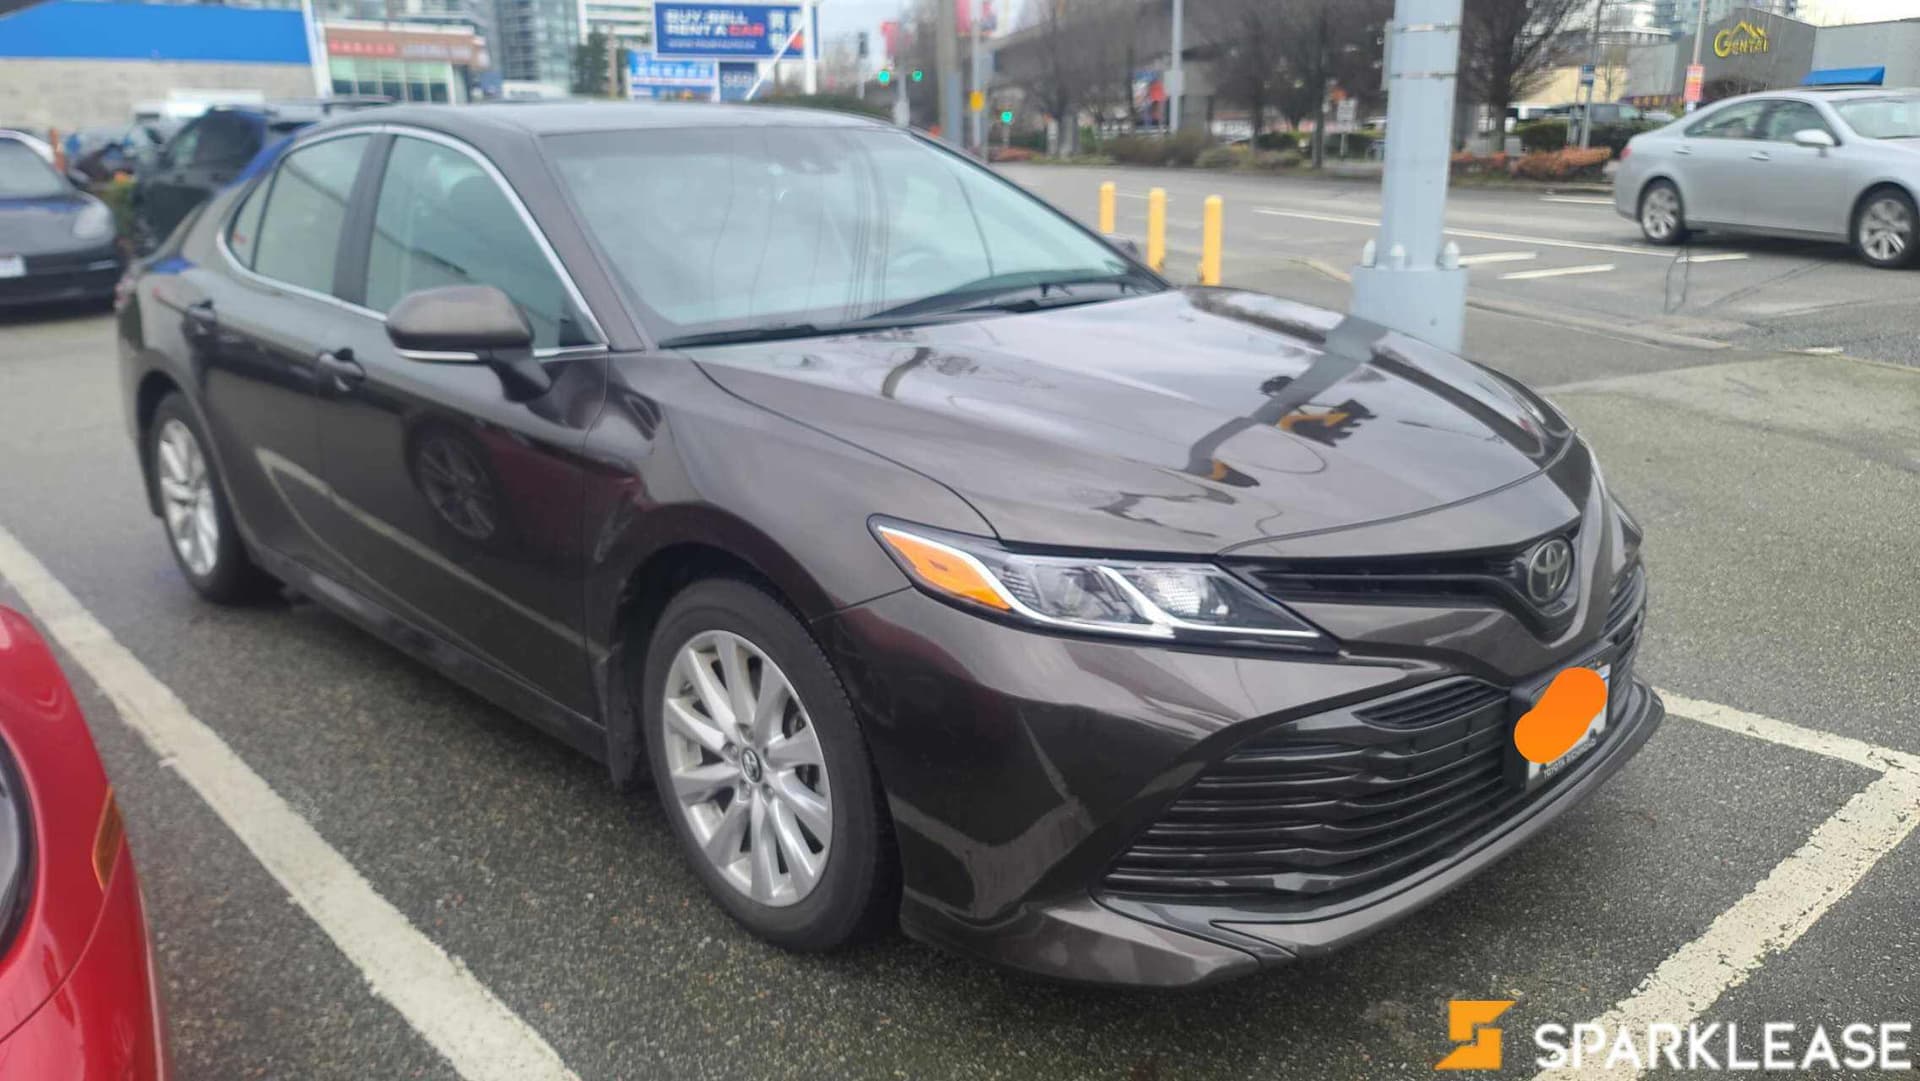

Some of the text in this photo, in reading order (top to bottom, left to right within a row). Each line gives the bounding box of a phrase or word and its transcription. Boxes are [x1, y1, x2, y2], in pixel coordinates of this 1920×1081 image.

[665, 24, 765, 37] RENT A CAR
